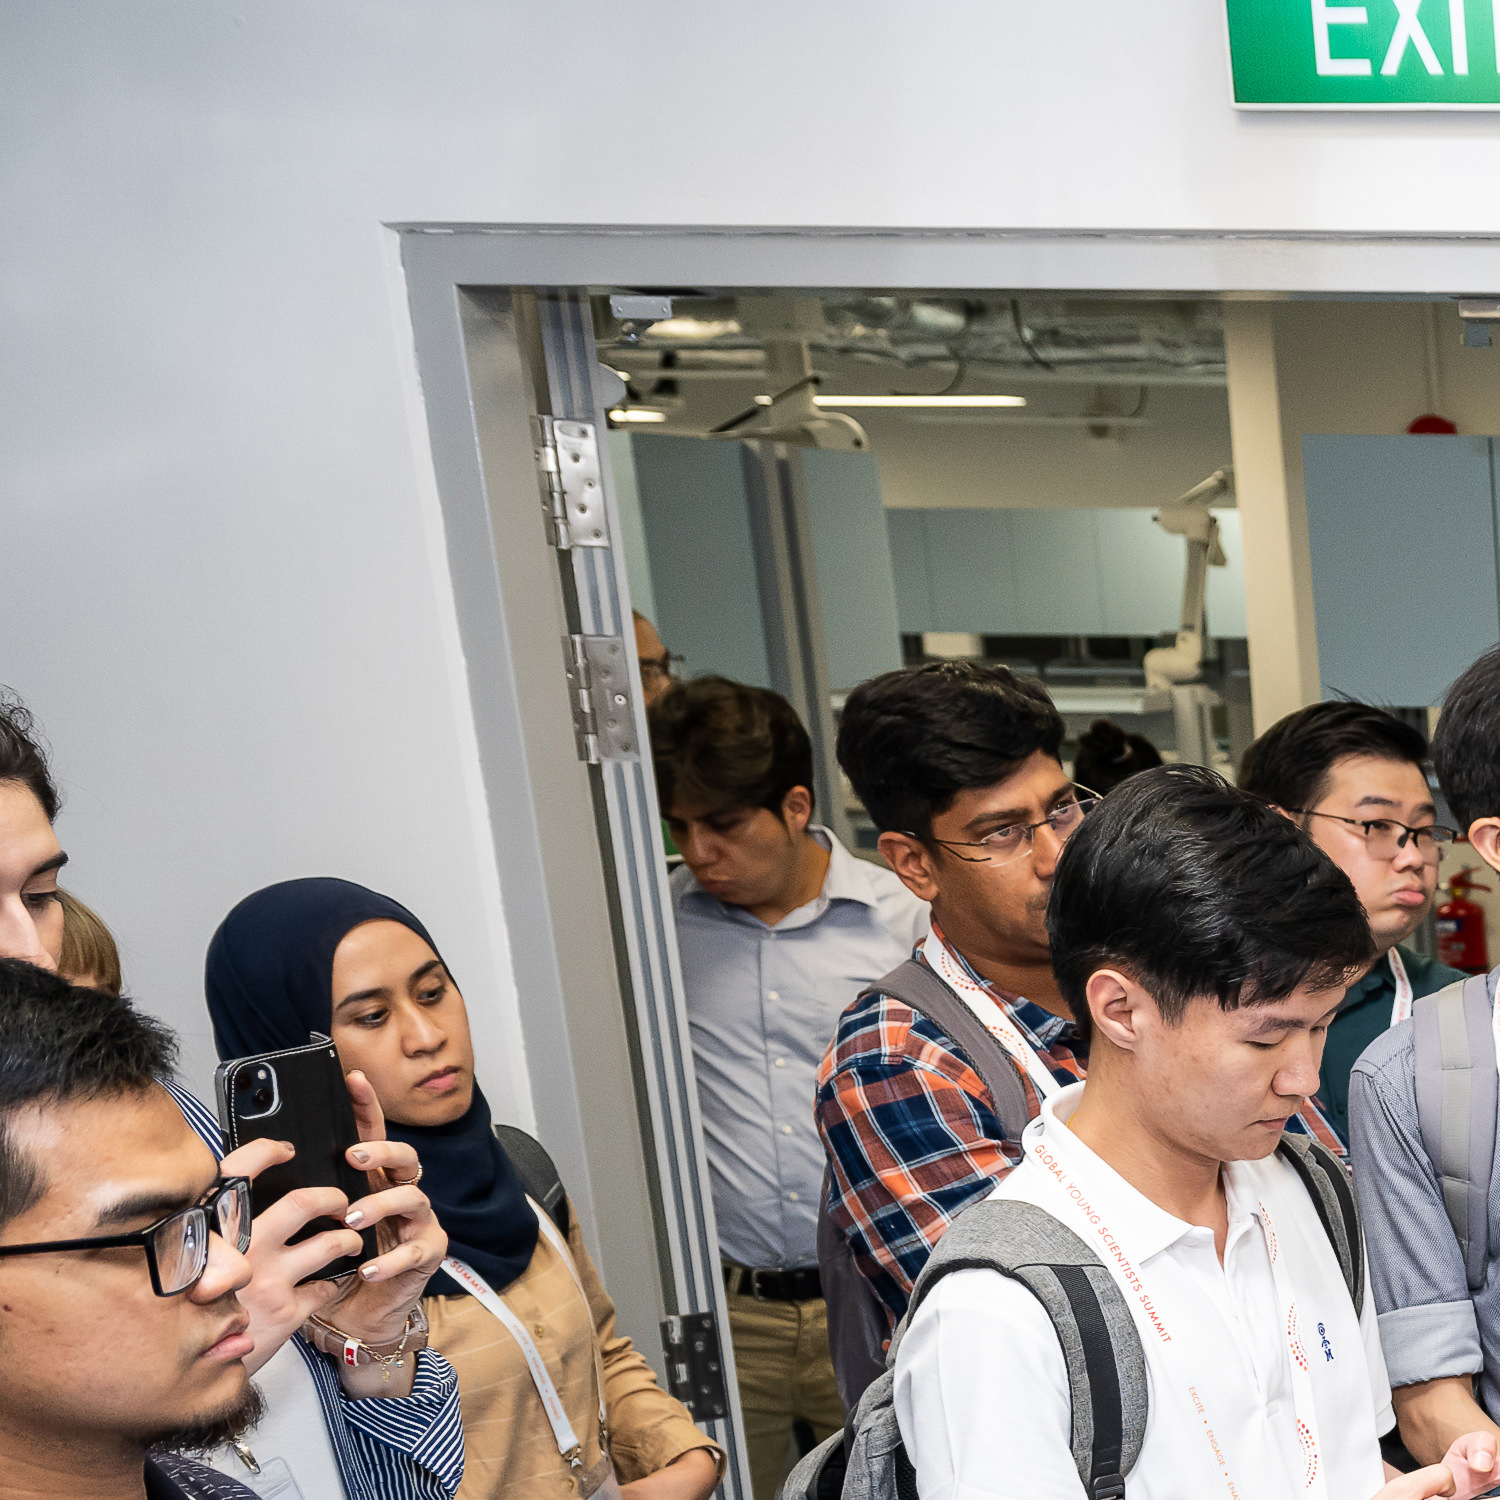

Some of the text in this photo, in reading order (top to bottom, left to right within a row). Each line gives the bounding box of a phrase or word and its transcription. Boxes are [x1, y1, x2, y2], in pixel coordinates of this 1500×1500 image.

[449, 1261, 487, 1296] SUMMIT
[1034, 1143, 1172, 1343] GLOBAL YOUNG SCIENTISTS SUMMIT
[1188, 1386, 1205, 1415] EXCITE
[1206, 1429, 1226, 1467] ENGAGE
